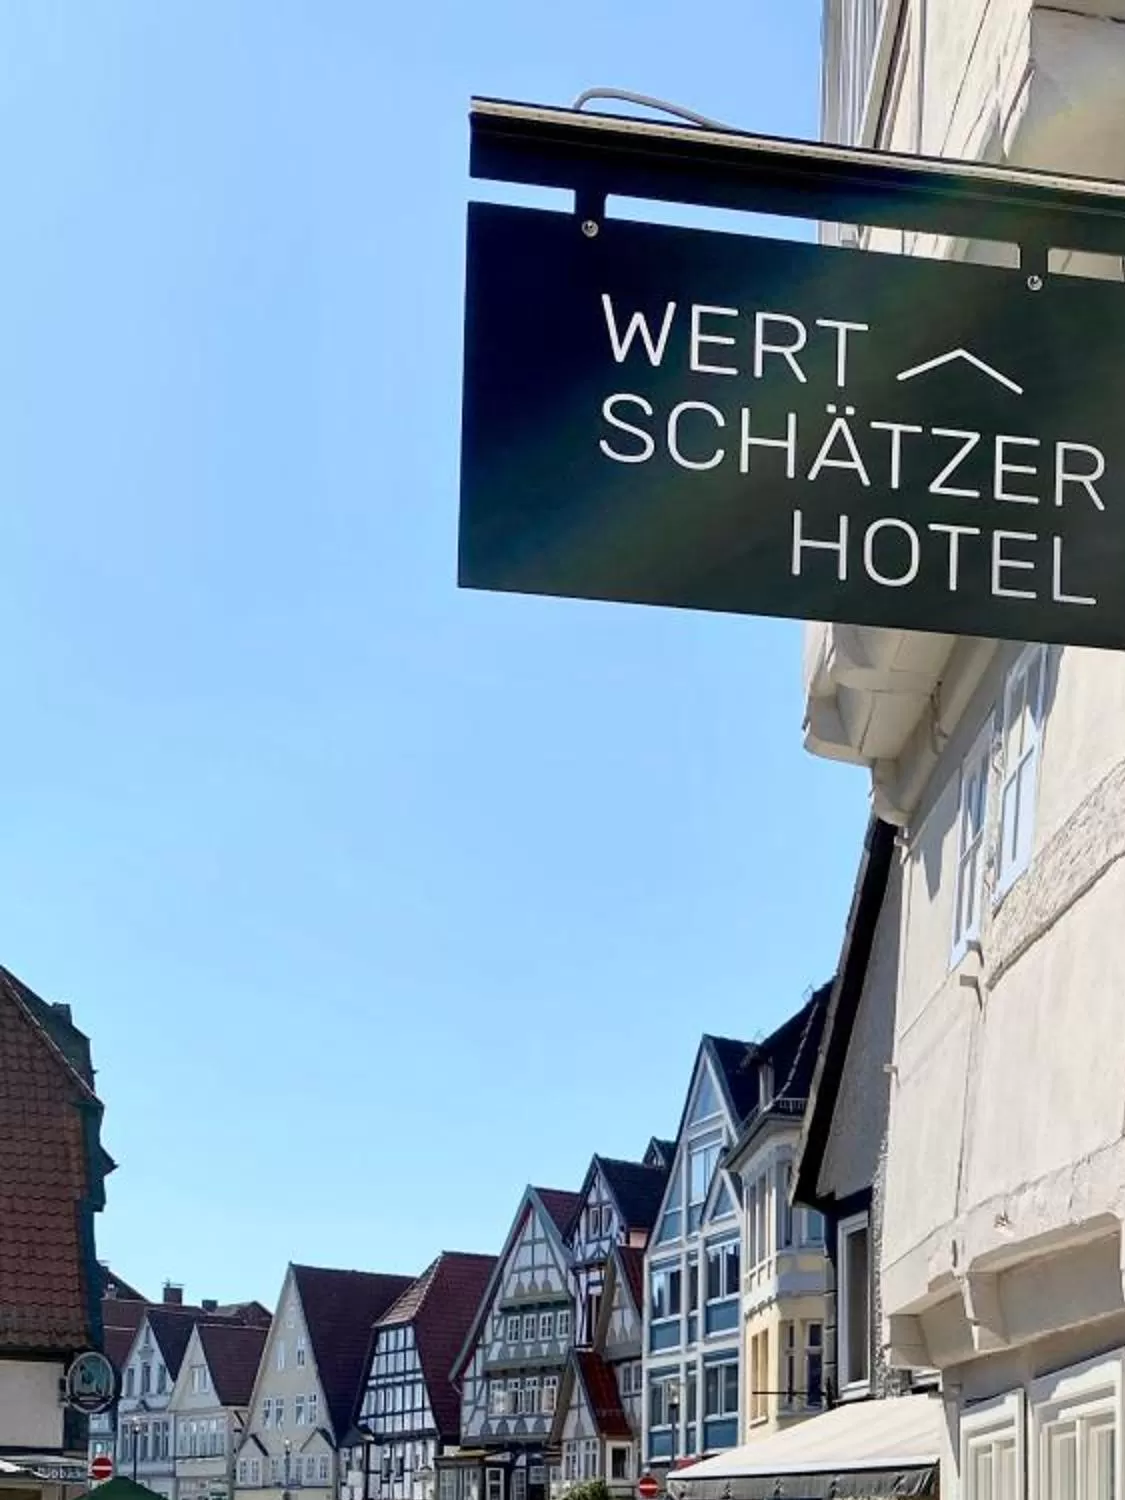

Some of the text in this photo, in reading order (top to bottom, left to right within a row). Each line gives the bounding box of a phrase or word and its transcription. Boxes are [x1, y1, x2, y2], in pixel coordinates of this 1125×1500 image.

[601, 293, 869, 387] WERT
[599, 393, 1105, 511] SCHÄTZER
[792, 509, 1097, 605] HOTEL
